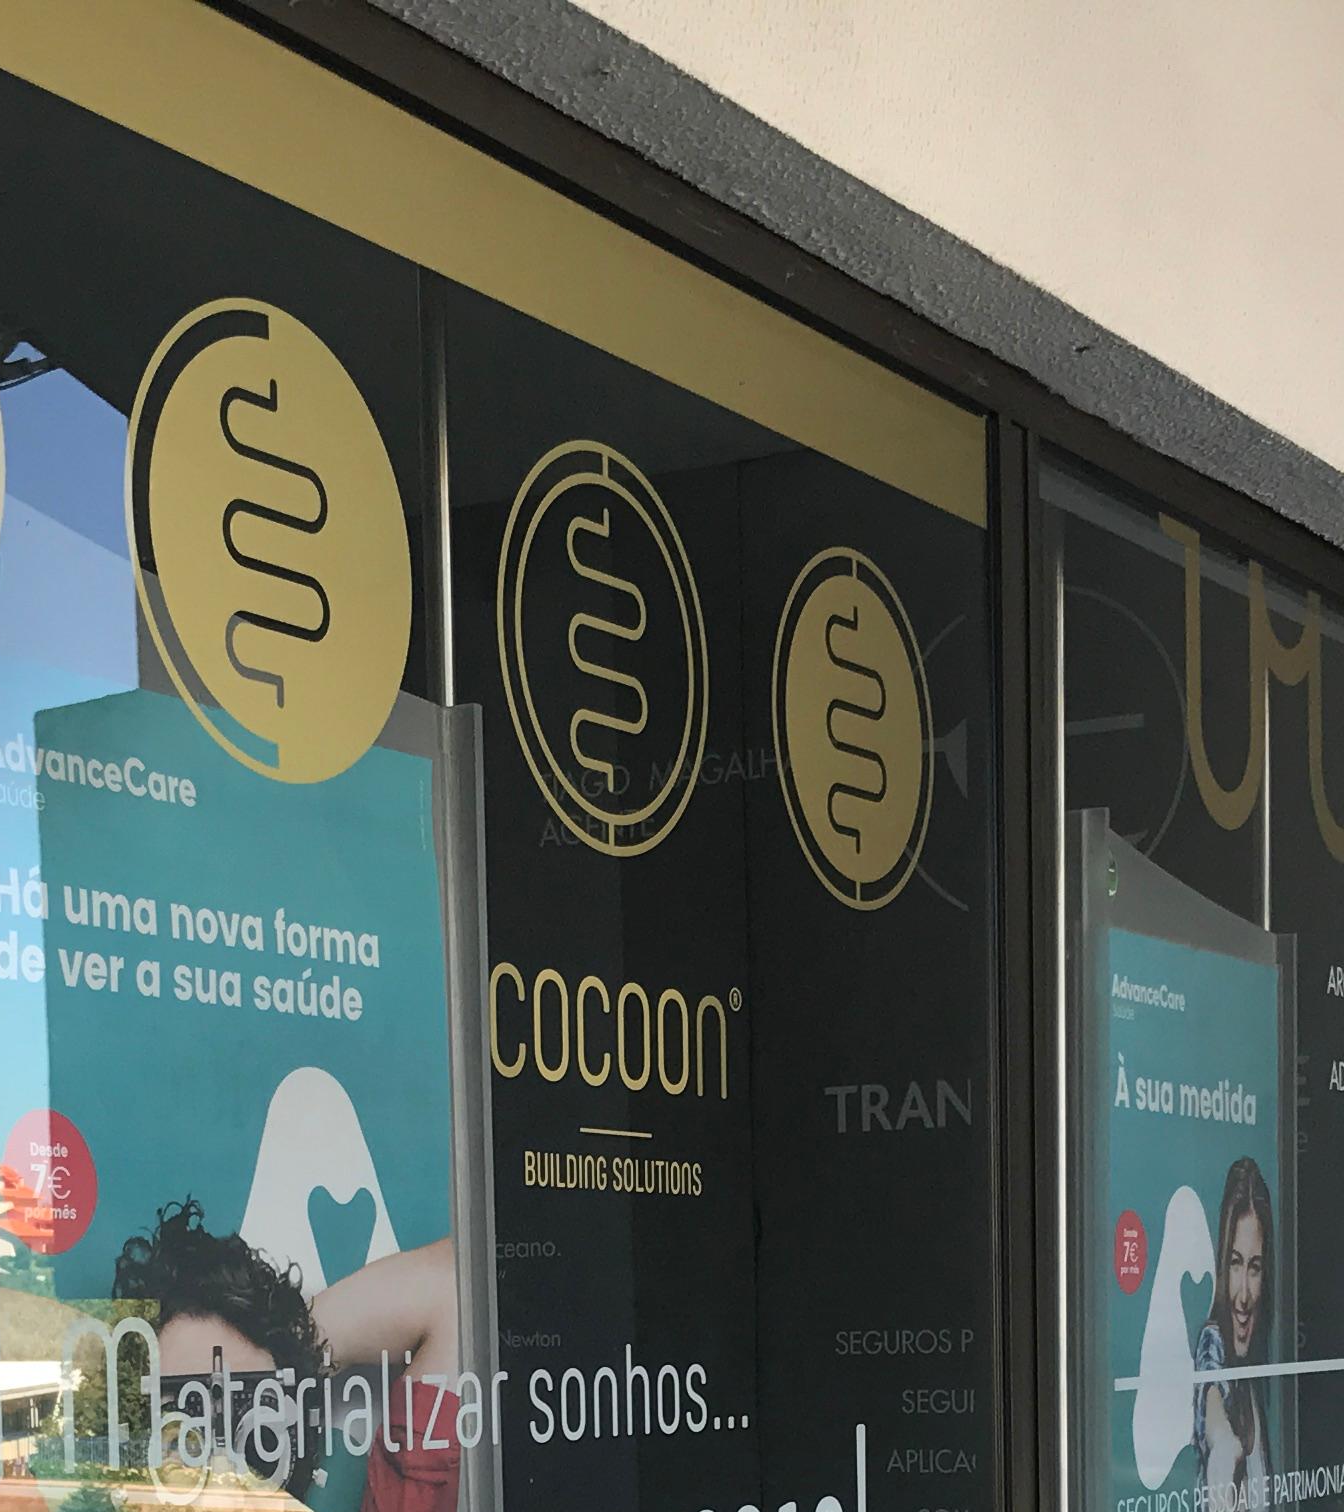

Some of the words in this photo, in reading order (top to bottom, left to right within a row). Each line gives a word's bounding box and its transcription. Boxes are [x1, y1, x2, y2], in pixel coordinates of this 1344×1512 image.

[64, 882, 158, 936] uma
[171, 902, 264, 952] nova
[274, 906, 380, 969] forma
[58, 944, 125, 993] ver
[136, 960, 160, 999] a
[173, 963, 243, 1008] sua
[253, 968, 363, 1021] saúde
[1111, 973, 1186, 1012] AdvanceCare
[1114, 1051, 1131, 1109] À
[1135, 1076, 1174, 1115] sua
[1179, 1079, 1257, 1126] medida
[29, 1142, 69, 1158] Desde
[30, 1161, 72, 1200] 7€
[523, 1151, 607, 1192] BUILDING
[612, 1157, 703, 1197] SOLUTIONS
[24, 1206, 48, 1223] por
[51, 1204, 77, 1220] mês
[1123, 1241, 1140, 1264] 7€
[835, 1329, 952, 1354] SEGUROS
[62, 1316, 510, 1475] Materializar
[528, 1343, 749, 1444] sonhos...
[1260, 1475, 1270, 1507] E
